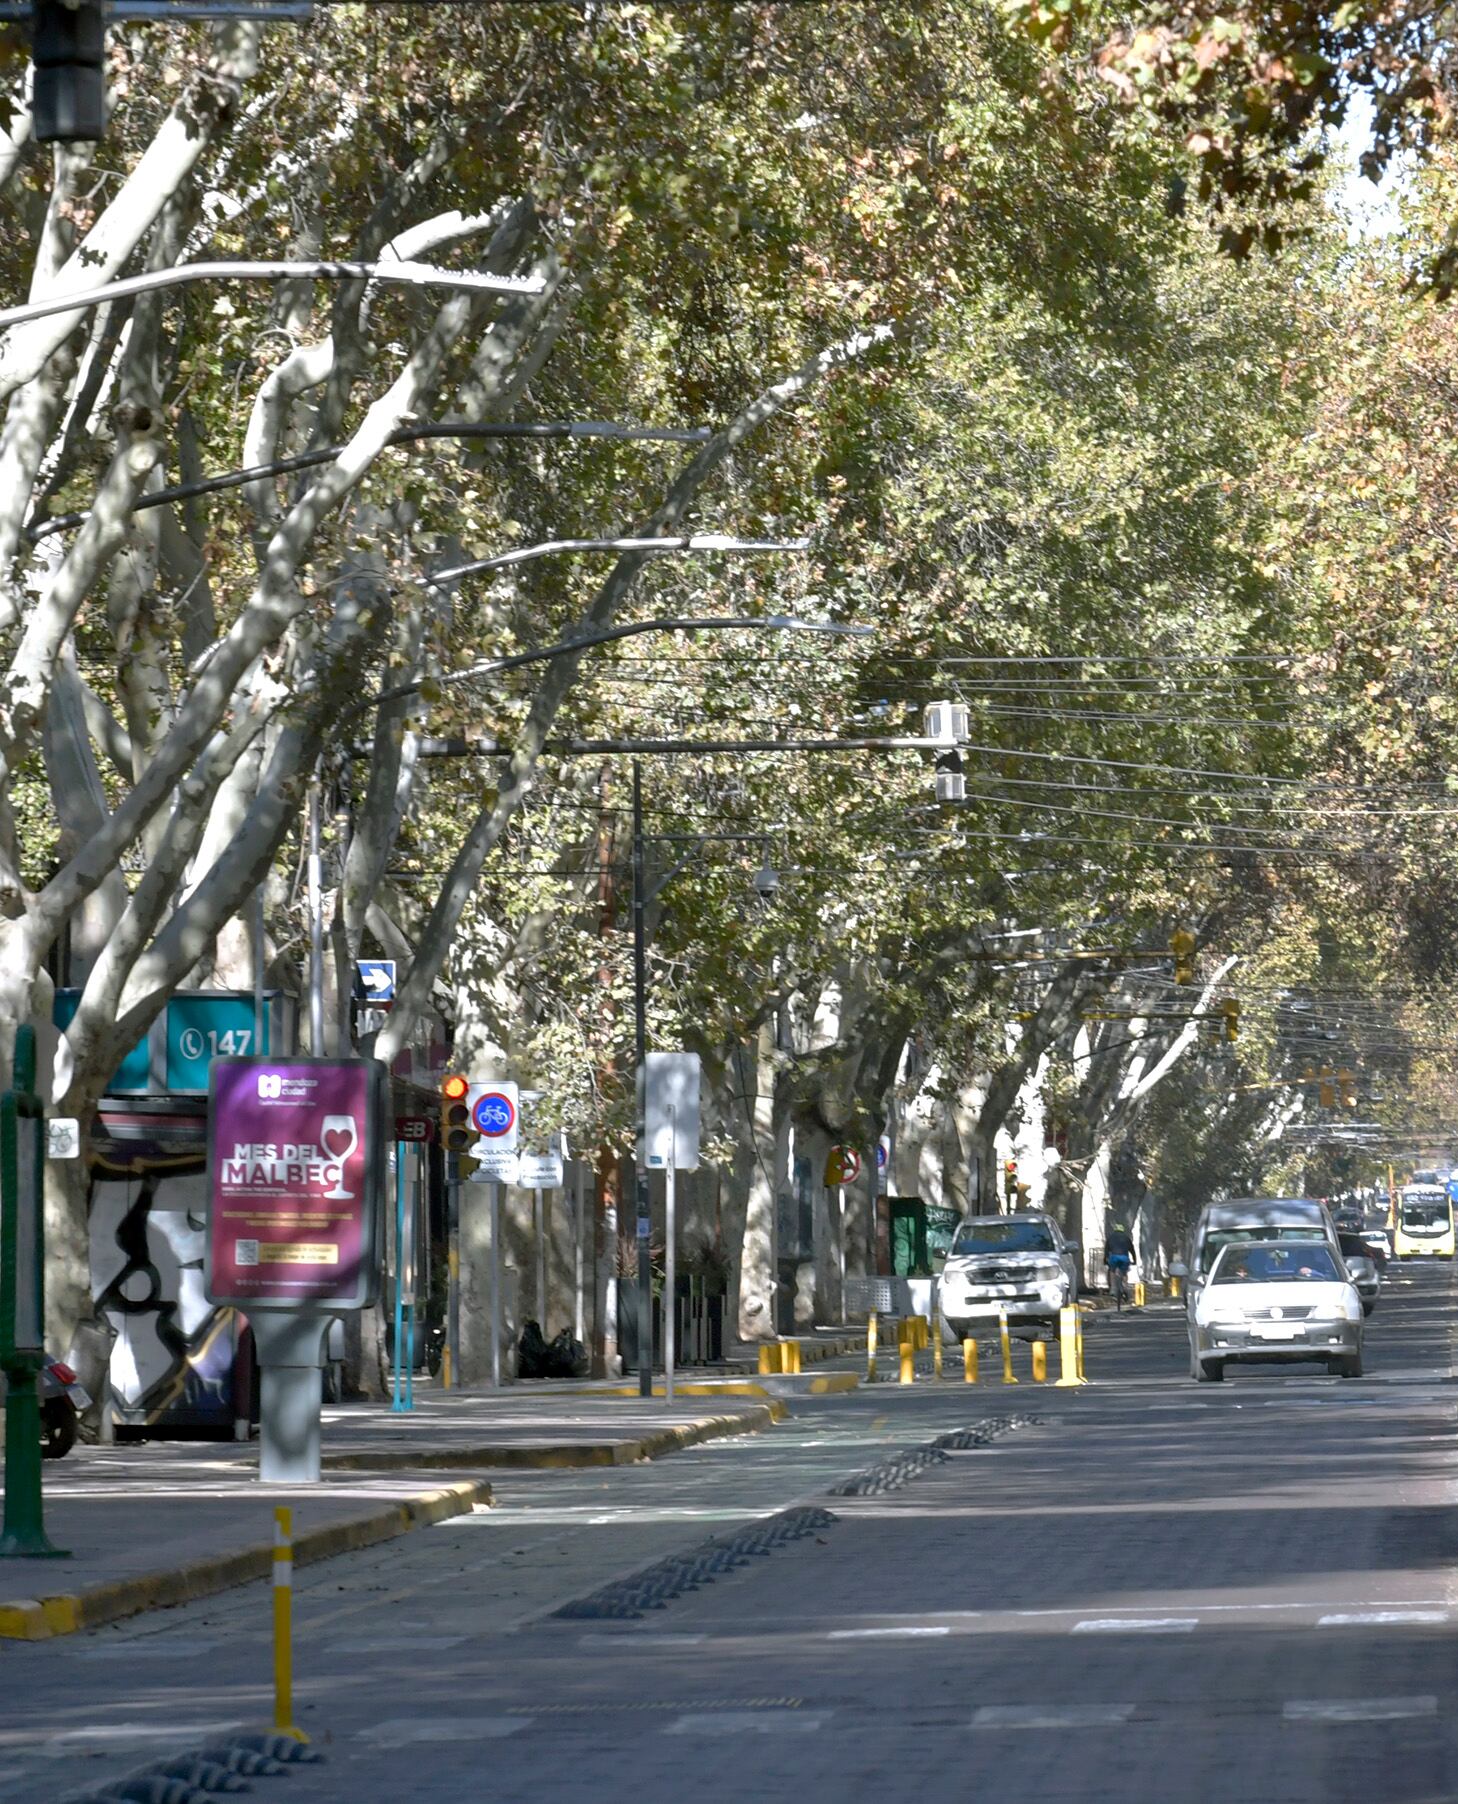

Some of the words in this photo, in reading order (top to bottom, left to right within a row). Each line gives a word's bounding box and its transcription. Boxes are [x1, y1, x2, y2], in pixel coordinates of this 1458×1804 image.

[207, 1029, 252, 1056] 147
[234, 1143, 278, 1161] MES
[282, 1143, 324, 1161] DEL
[224, 1161, 342, 1184] MALBEC
